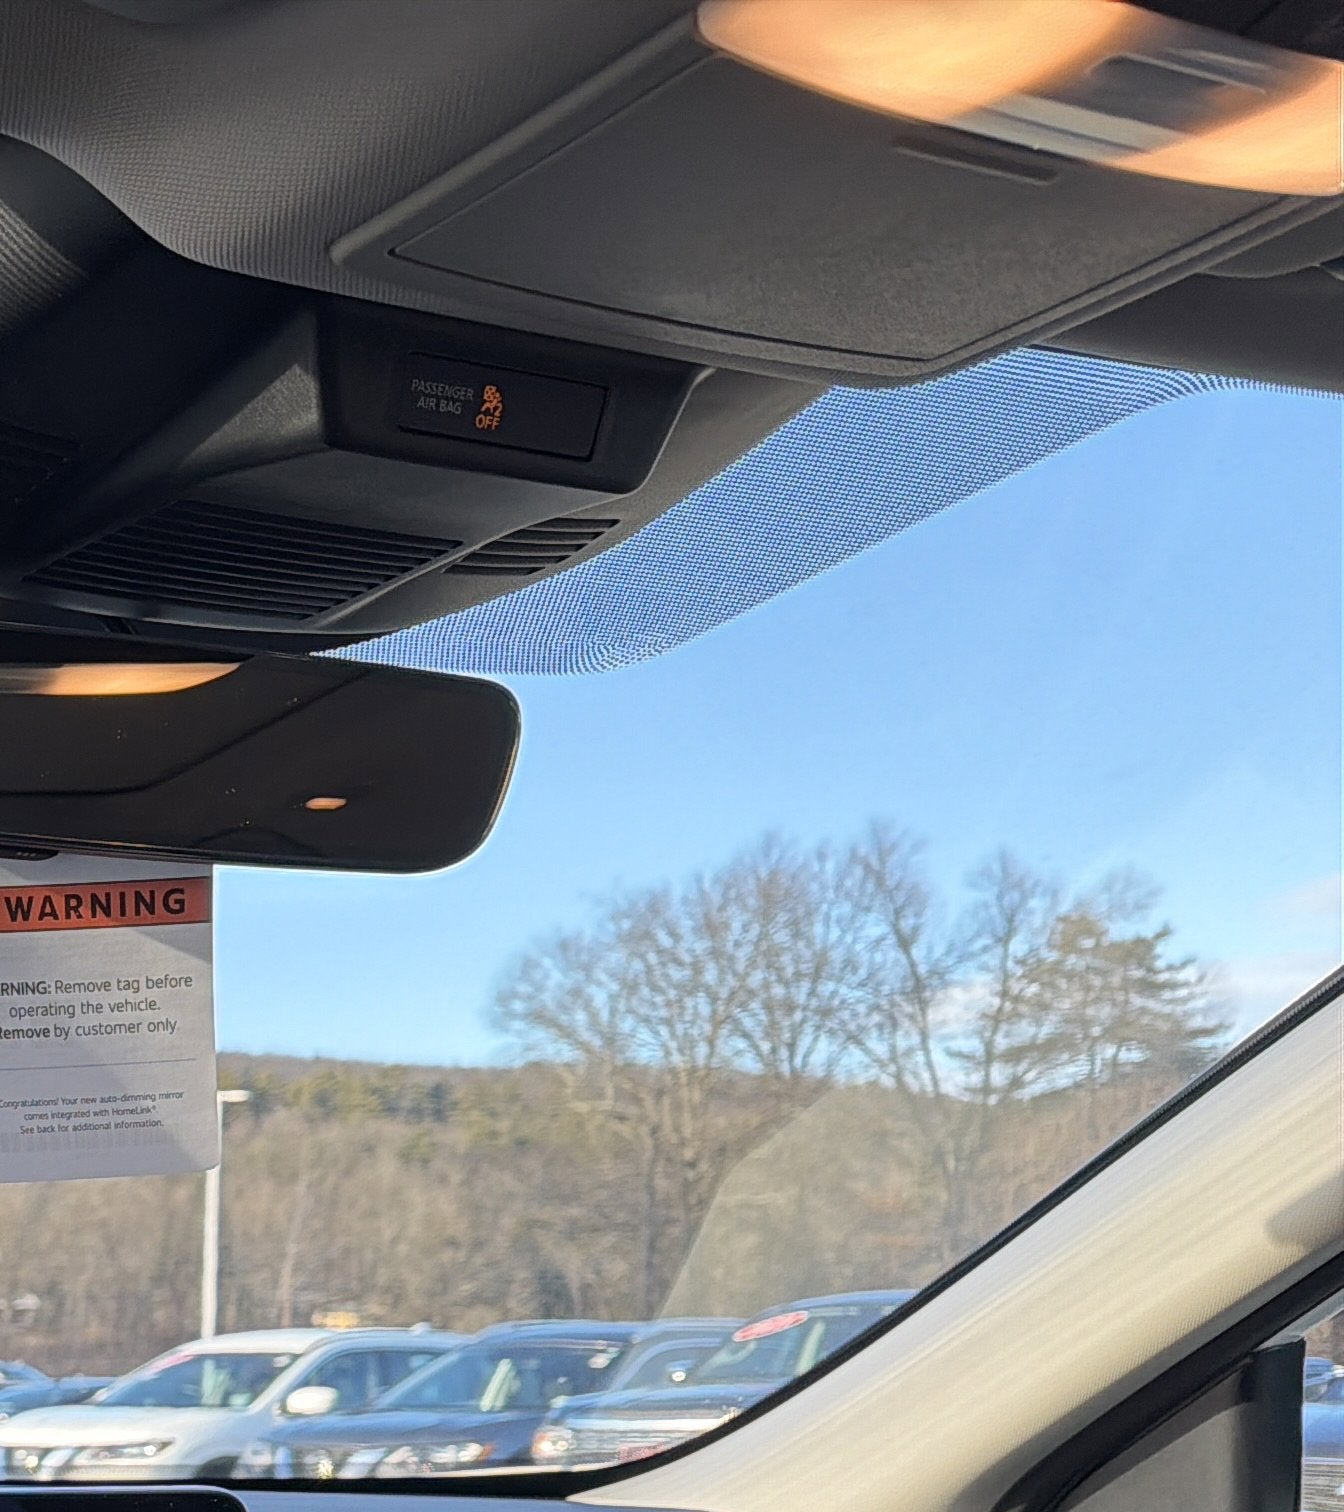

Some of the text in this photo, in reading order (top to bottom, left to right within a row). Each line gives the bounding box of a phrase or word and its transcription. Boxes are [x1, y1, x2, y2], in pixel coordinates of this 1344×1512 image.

[412, 379, 474, 401] PASSENGER
[417, 397, 462, 415] AIR BAG
[475, 414, 501, 430] OFF
[4, 888, 186, 923] WARNING
[55, 979, 112, 995] Remove
[116, 977, 140, 993] tag
[145, 974, 193, 990] before
[9, 997, 161, 1020] operating the vehicle.
[54, 1024, 71, 1041] by
[75, 1021, 142, 1037] customer
[80, 1097, 97, 1105] new
[158, 1091, 184, 1101] mirror
[24, 1112, 49, 1121] comes
[92, 1108, 109, 1118] with
[20, 1125, 35, 1134] See
[36, 1124, 56, 1134] back
[58, 1123, 69, 1132] for
[71, 1121, 112, 1132] additional
